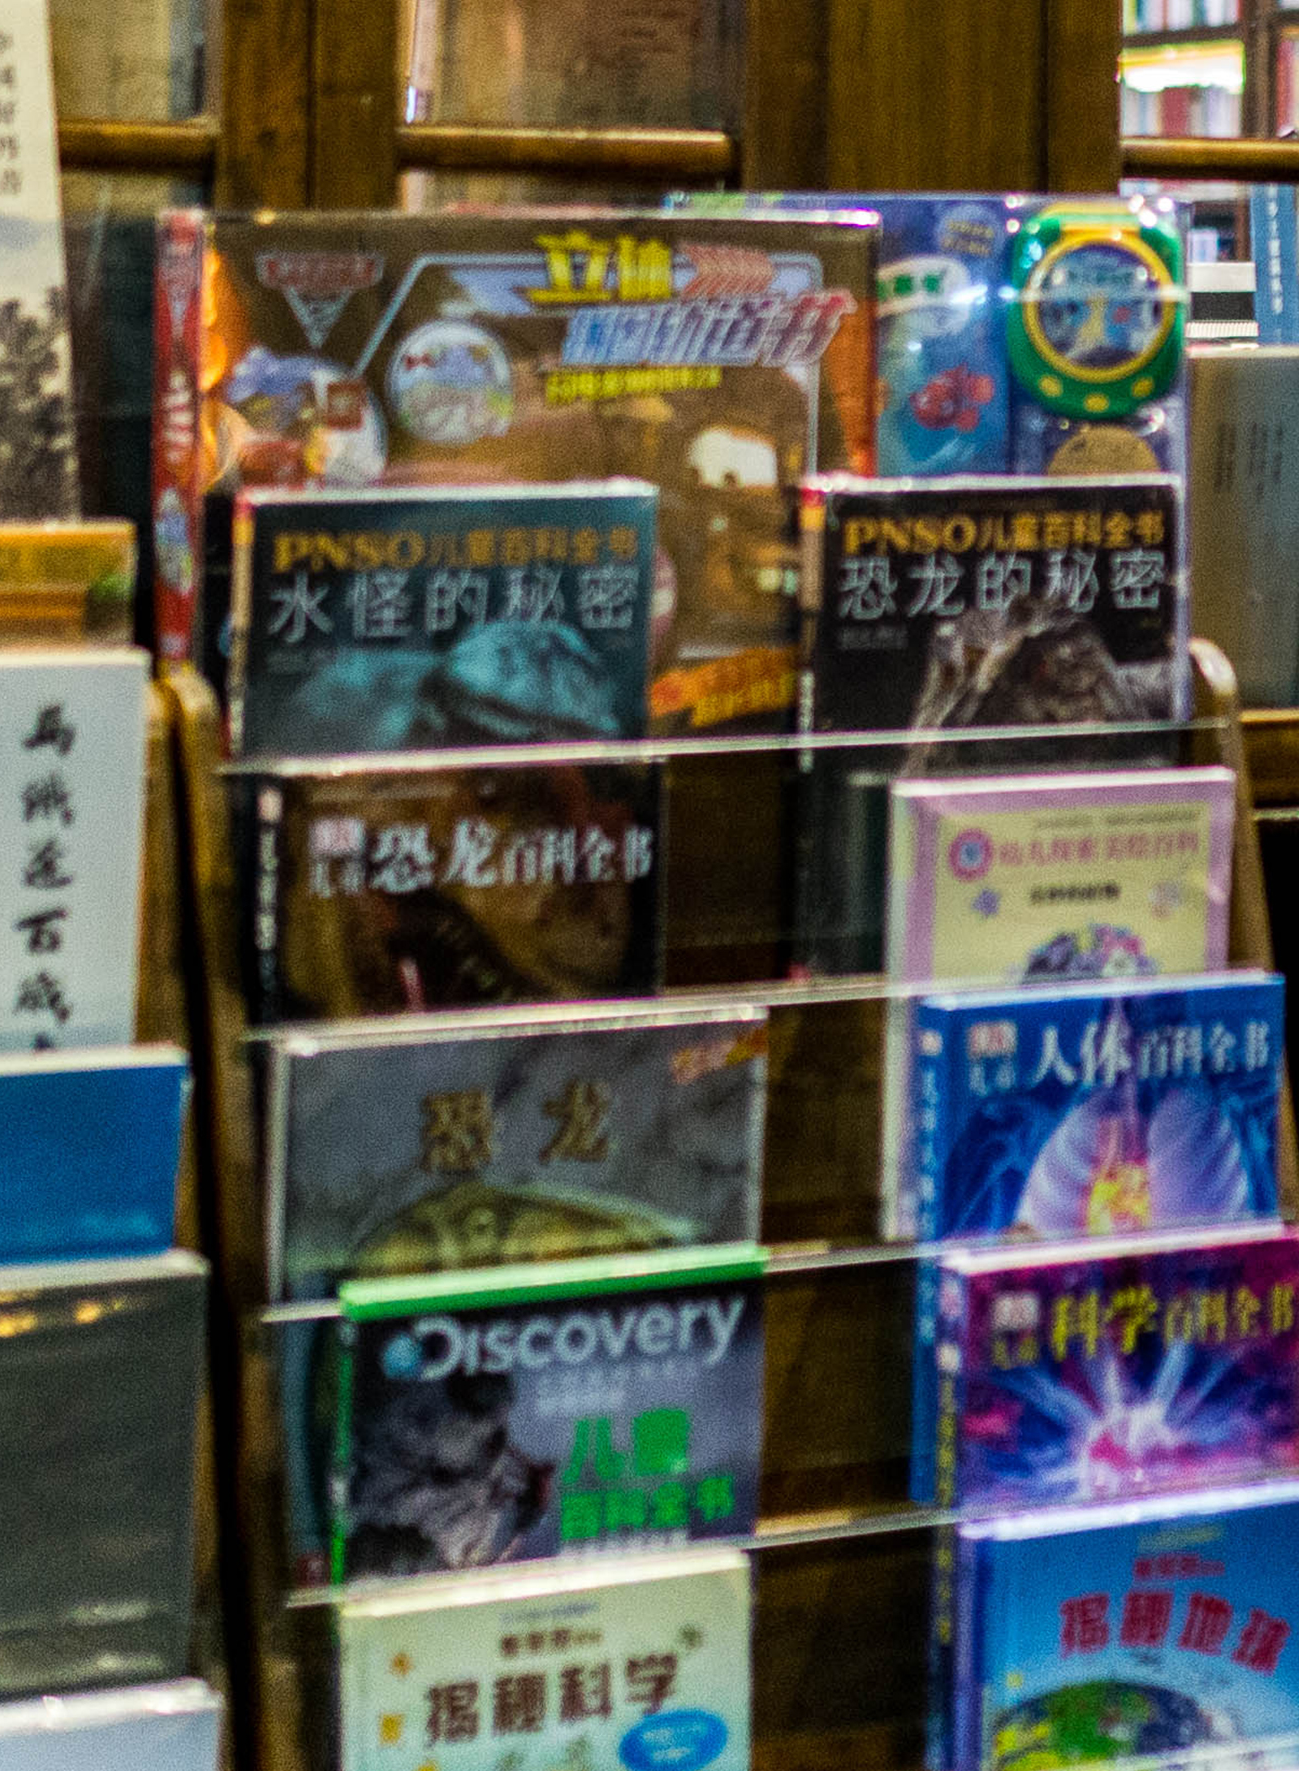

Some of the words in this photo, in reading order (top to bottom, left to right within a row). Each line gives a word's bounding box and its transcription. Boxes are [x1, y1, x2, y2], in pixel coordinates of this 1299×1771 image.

[268, 560, 640, 645] 水怪的秘密
[838, 547, 1166, 621] 恐龙的秘密
[392, 1294, 747, 1382] Discovery
